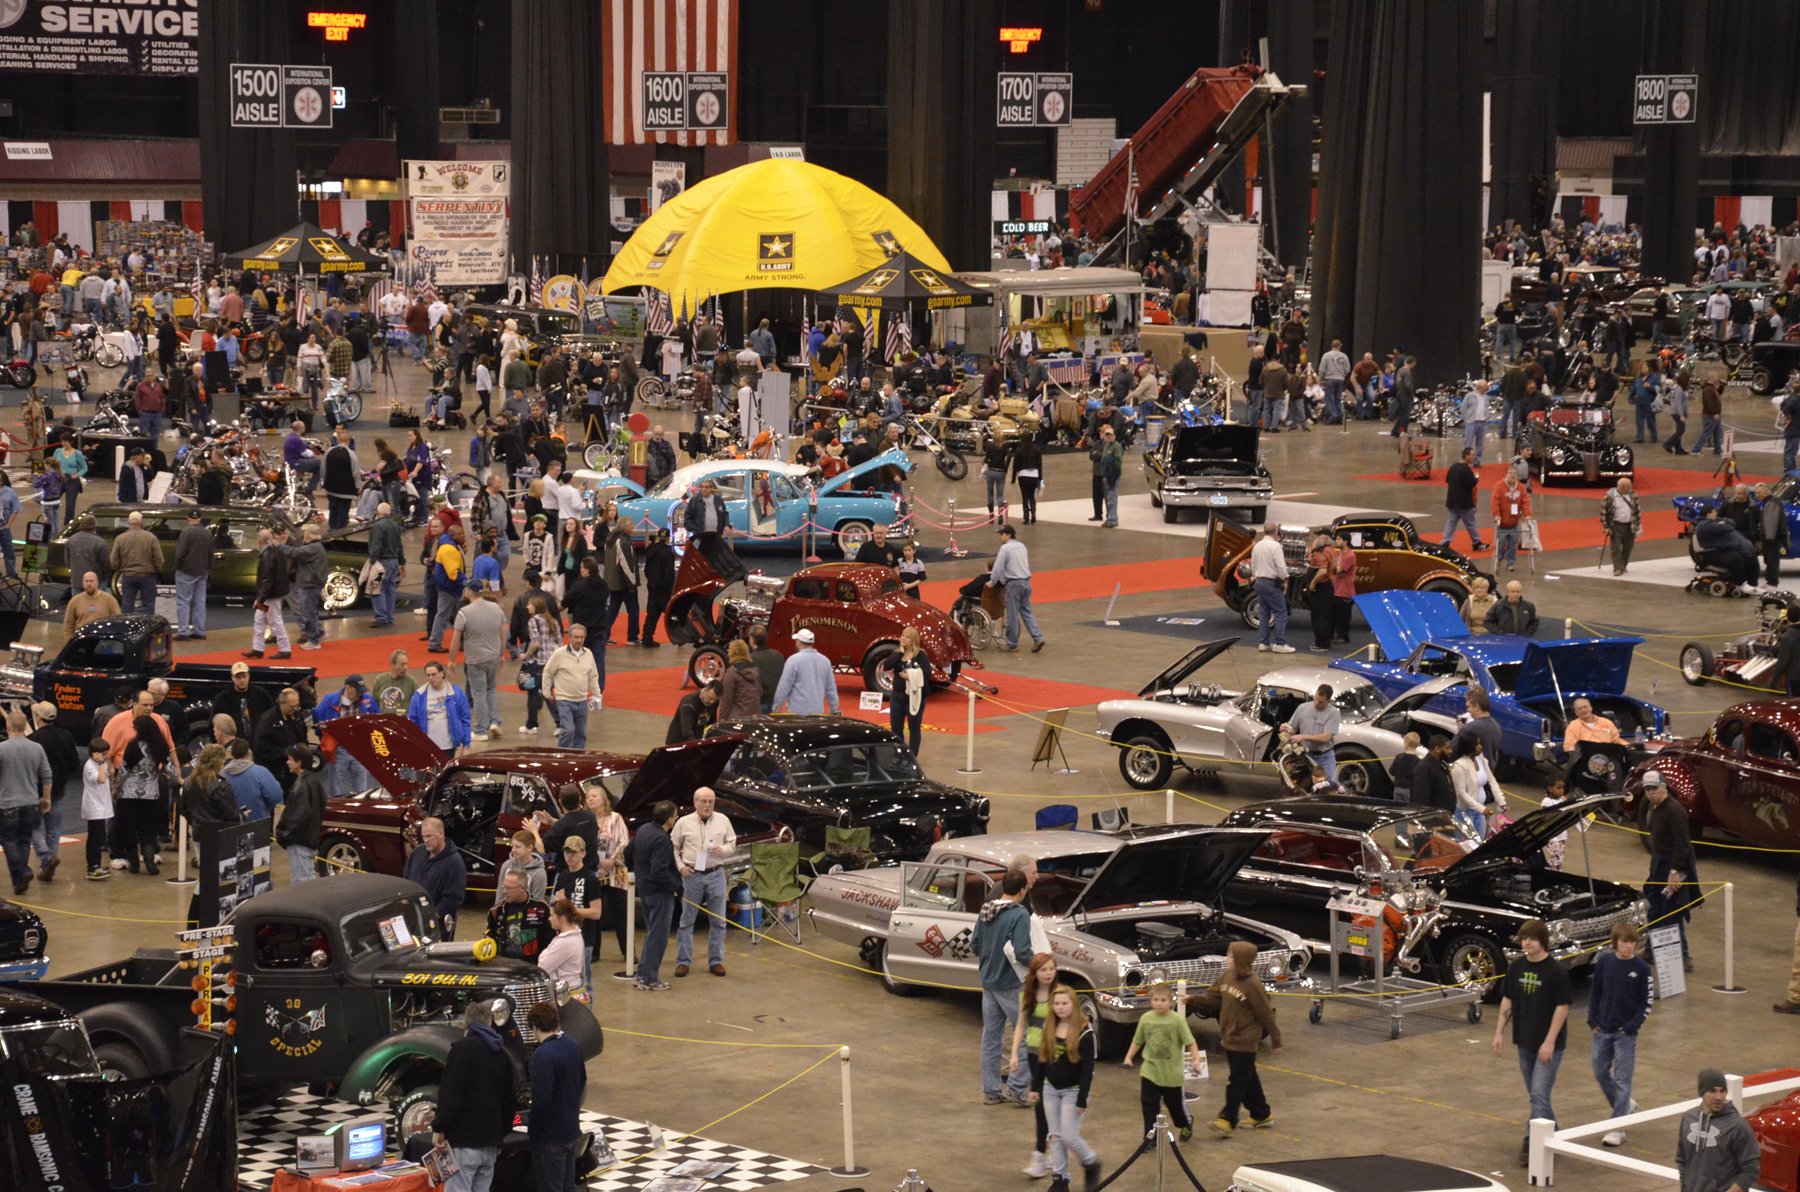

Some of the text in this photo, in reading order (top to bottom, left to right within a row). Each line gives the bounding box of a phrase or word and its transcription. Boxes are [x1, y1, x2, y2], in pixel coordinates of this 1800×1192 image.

[308, 12, 366, 27] EMERGENCY
[325, 27, 349, 41] EXIT
[1000, 28, 1042, 41] EMERGENCY
[36, 37, 86, 45] EQUIPMENT
[151, 41, 189, 49] UTILITIES
[1010, 41, 1029, 53] EXIT
[51, 46, 101, 54] DISMANTLING
[103, 47, 128, 55] LABOR
[33, 53, 77, 61] HANDLING
[88, 55, 129, 63] SHIPPING
[35, 61, 77, 69] SERVICES
[234, 70, 278, 97] 1500
[285, 77, 330, 86] EXPOSITION CENTER
[646, 77, 683, 102] 1600
[1000, 77, 1032, 100] 1700
[1637, 79, 1664, 101] 1800
[235, 103, 278, 122] AISLE
[646, 107, 683, 125] AISLE
[1000, 105, 1032, 122] AISLE
[1636, 104, 1663, 119] AISLE
[437, 163, 483, 175] WELCOME
[417, 201, 503, 213] SERPENTINI
[1002, 221, 1049, 233] COLD BEER
[242, 259, 279, 271] goarmy.com
[320, 261, 366, 273] goarmy.com
[838, 294, 882, 307] goarmy.com
[927, 295, 972, 310] goarmy.com
[789, 614, 858, 634] PHENOMENON
[53, 683, 81, 694] Finders
[55, 691, 81, 702] Casper
[58, 700, 85, 710] Watson
[370, 729, 390, 757] 425HP
[510, 776, 536, 802] 613 S/S
[183, 928, 234, 941] PRE-STAGE
[192, 948, 224, 959] STAGE
[401, 973, 479, 986] 301 CU. IN.
[286, 999, 301, 1009] 38
[269, 1037, 322, 1057] SPECIAL
[13, 1084, 39, 1116] CRANE
[29, 1132, 60, 1181] RAMSONIC
